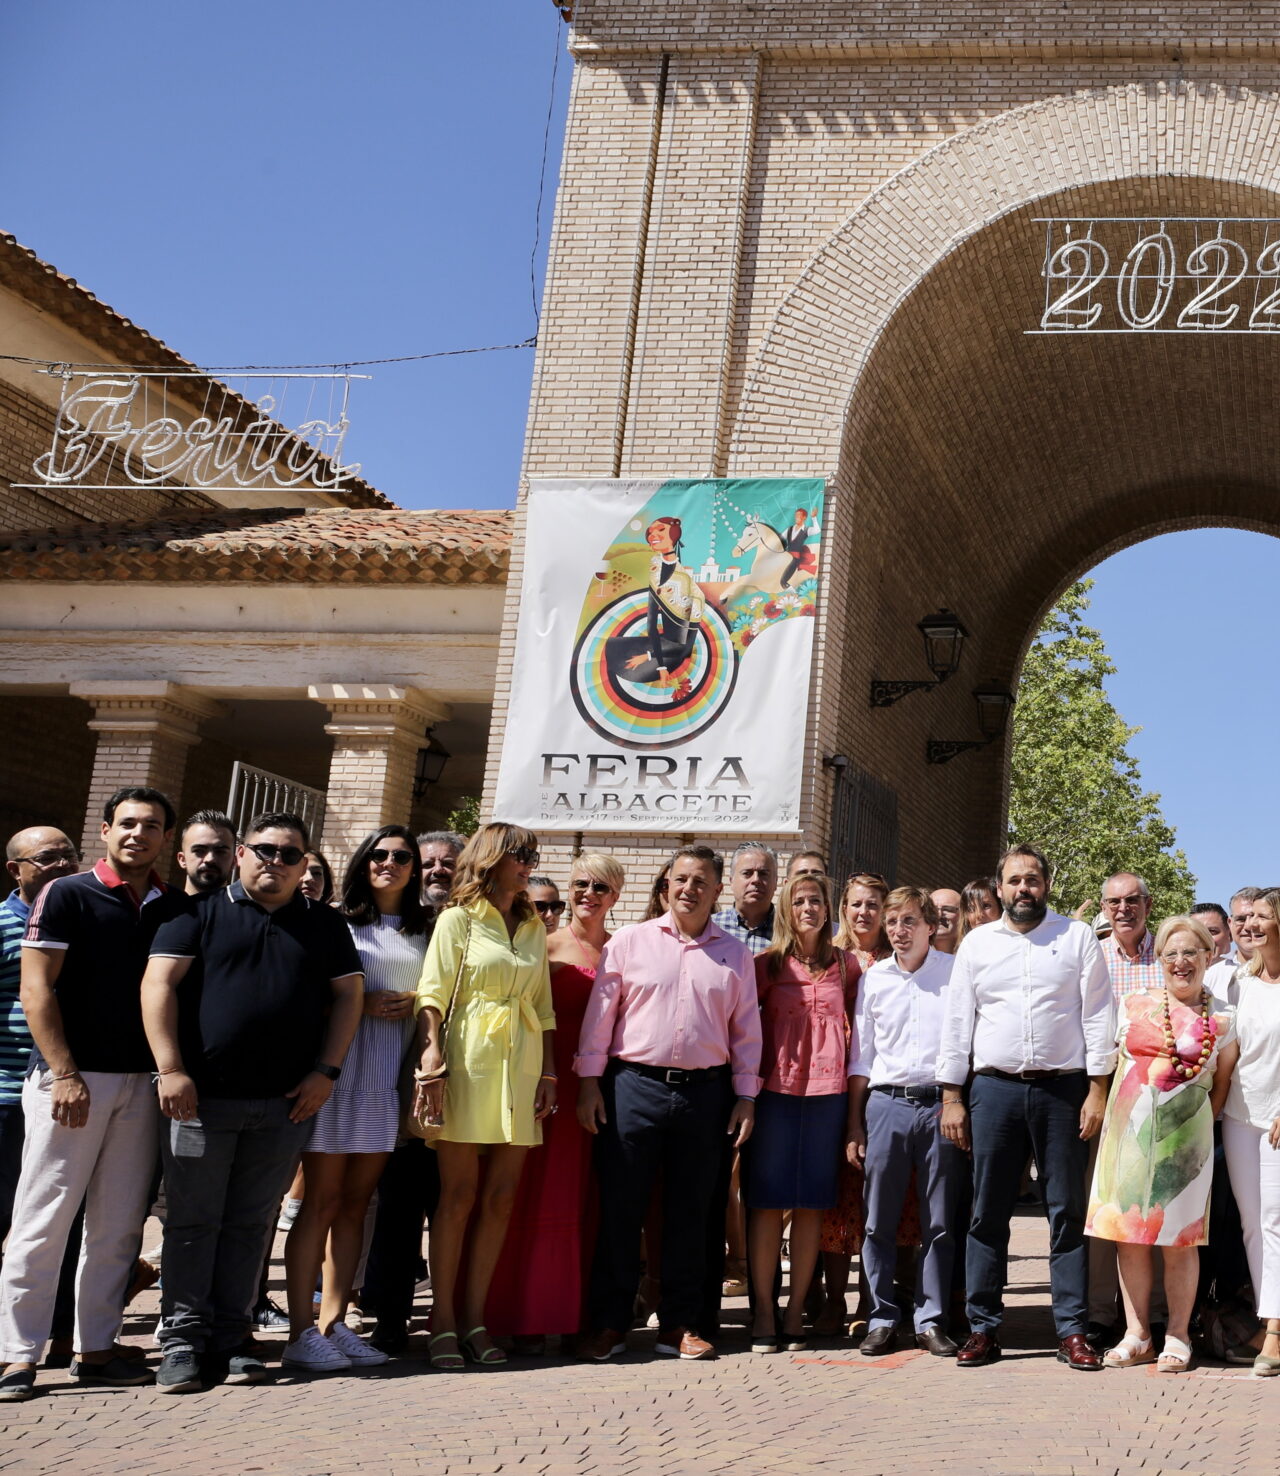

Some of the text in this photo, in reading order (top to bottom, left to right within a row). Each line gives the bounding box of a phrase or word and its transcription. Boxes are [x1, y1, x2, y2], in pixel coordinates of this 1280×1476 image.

[32, 379, 362, 487] Feria
[538, 753, 755, 791] FERIA
[551, 792, 752, 813] ALBACETE
[565, 813, 574, 821] 7
[714, 814, 749, 823] 2022
